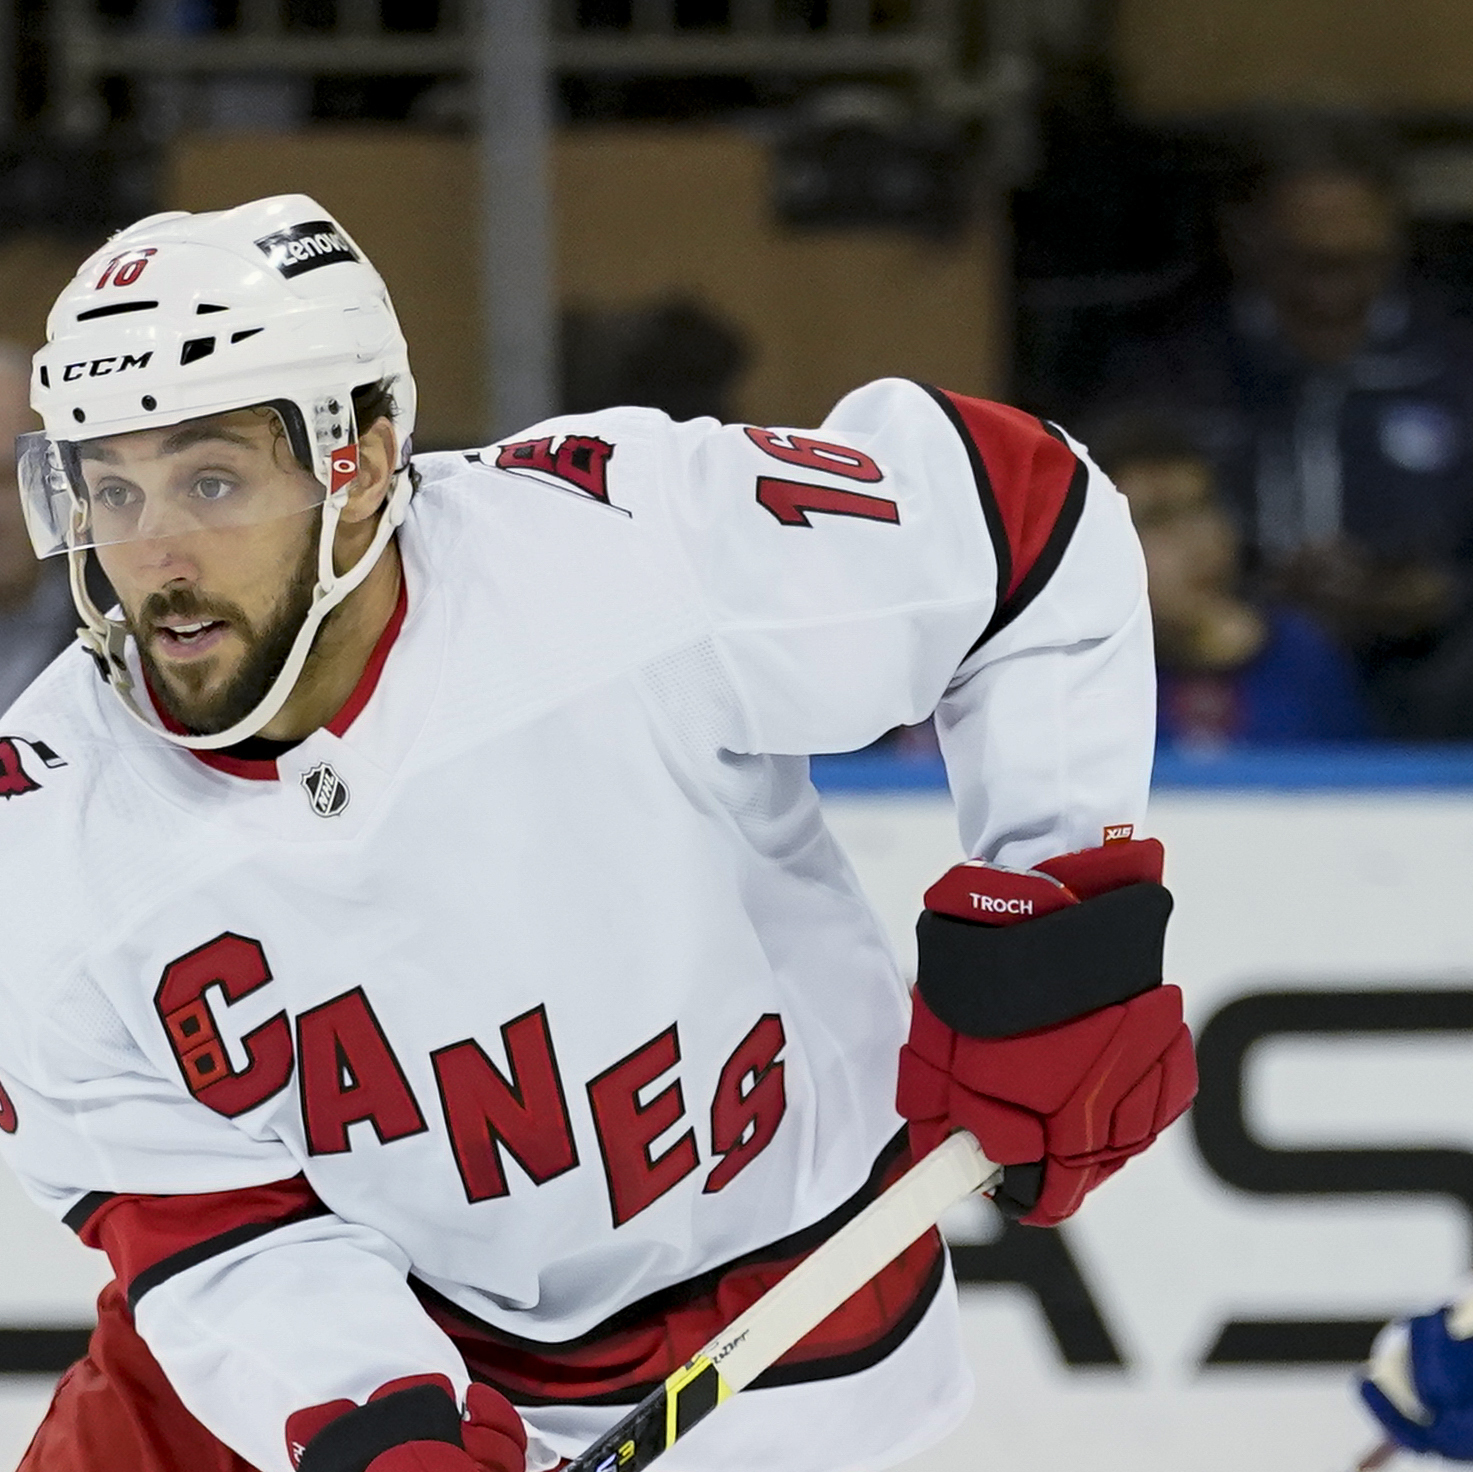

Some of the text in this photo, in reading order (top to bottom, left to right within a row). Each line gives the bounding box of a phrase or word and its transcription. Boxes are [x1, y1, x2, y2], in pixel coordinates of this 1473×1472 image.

[95, 247, 159, 291] 16
[63, 351, 155, 382] CCM
[743, 427, 901, 528] 16
[318, 773, 334, 811] NHL
[969, 893, 1034, 915] TROCH
[153, 931, 786, 1229] CANES
